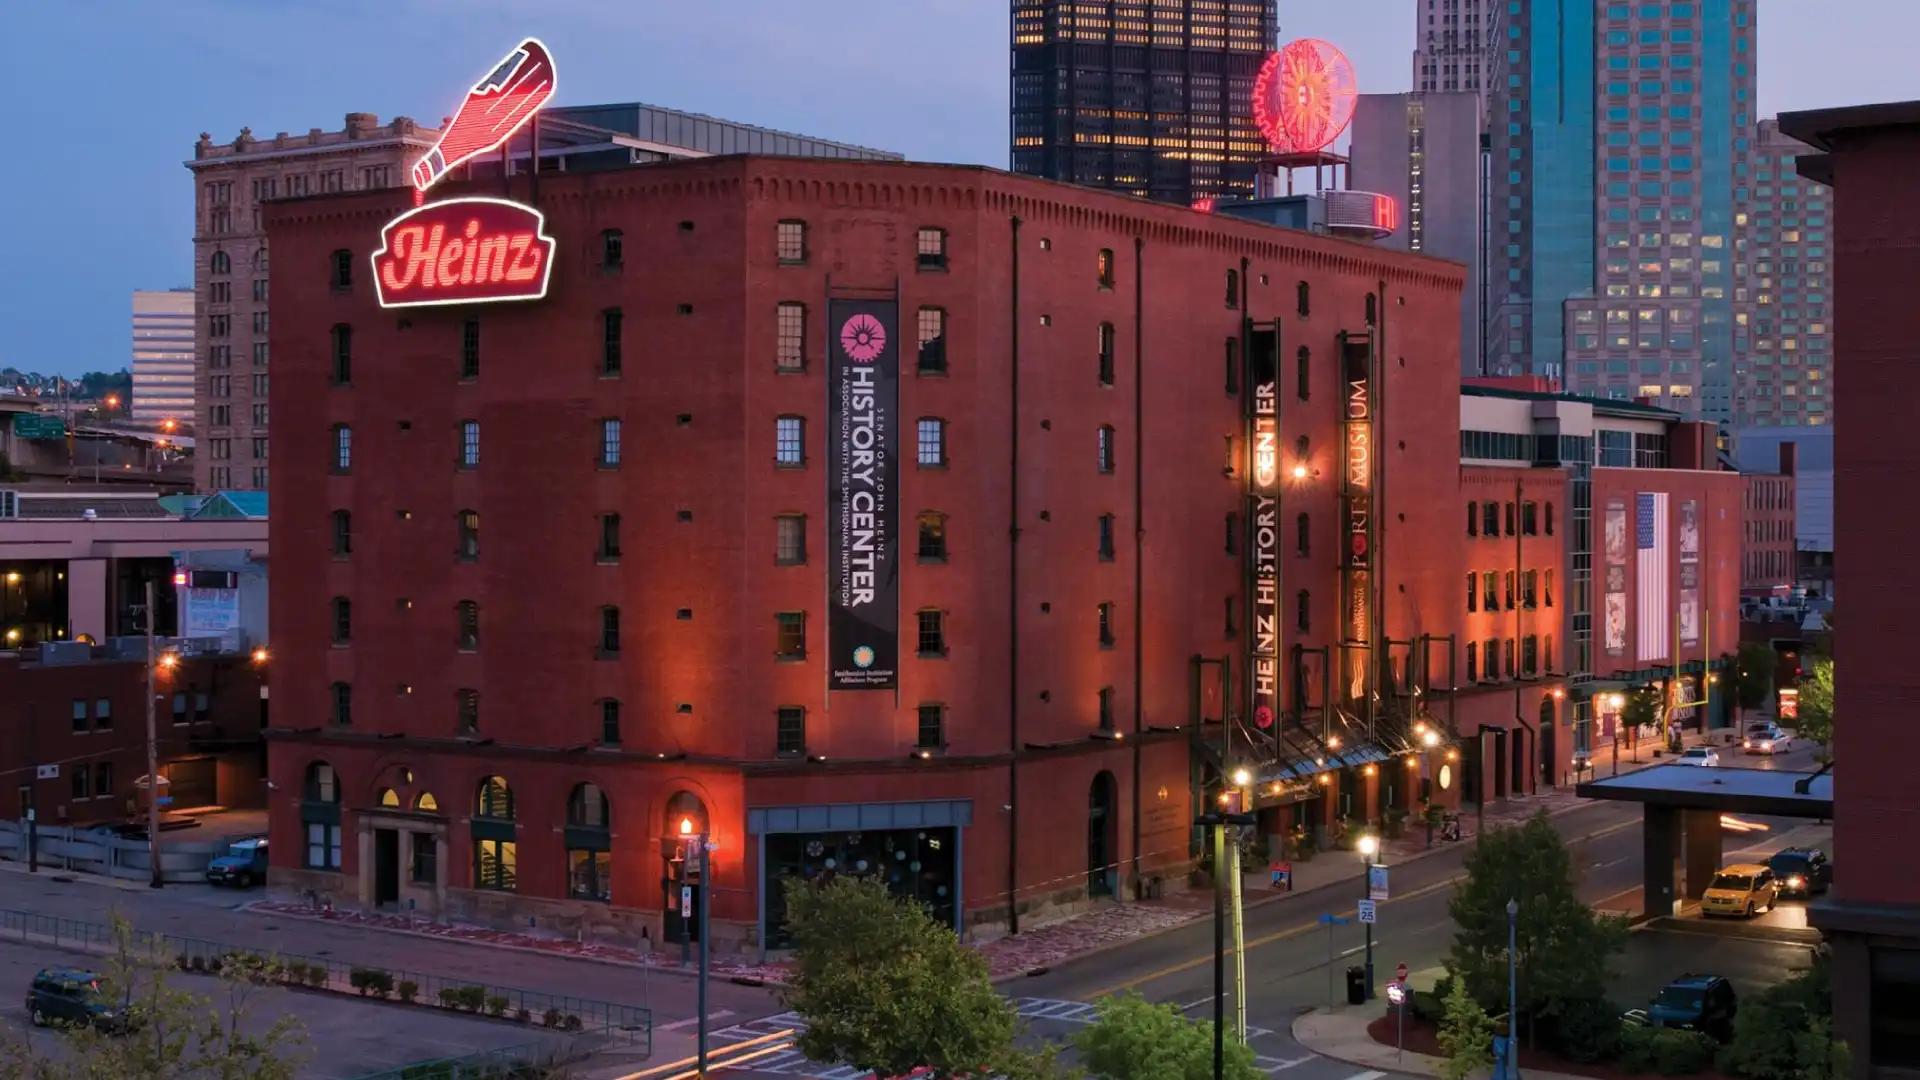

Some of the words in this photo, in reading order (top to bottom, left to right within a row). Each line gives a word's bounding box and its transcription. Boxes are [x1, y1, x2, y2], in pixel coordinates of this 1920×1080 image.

[383, 220, 541, 289] Heinz
[842, 366, 849, 376] IN
[852, 367, 874, 487] HISTORY
[1256, 382, 1275, 487] CENTER
[852, 491, 874, 608] CENTER
[1256, 615, 1275, 695] HENZ
[1361, 911, 1373, 920] 25
